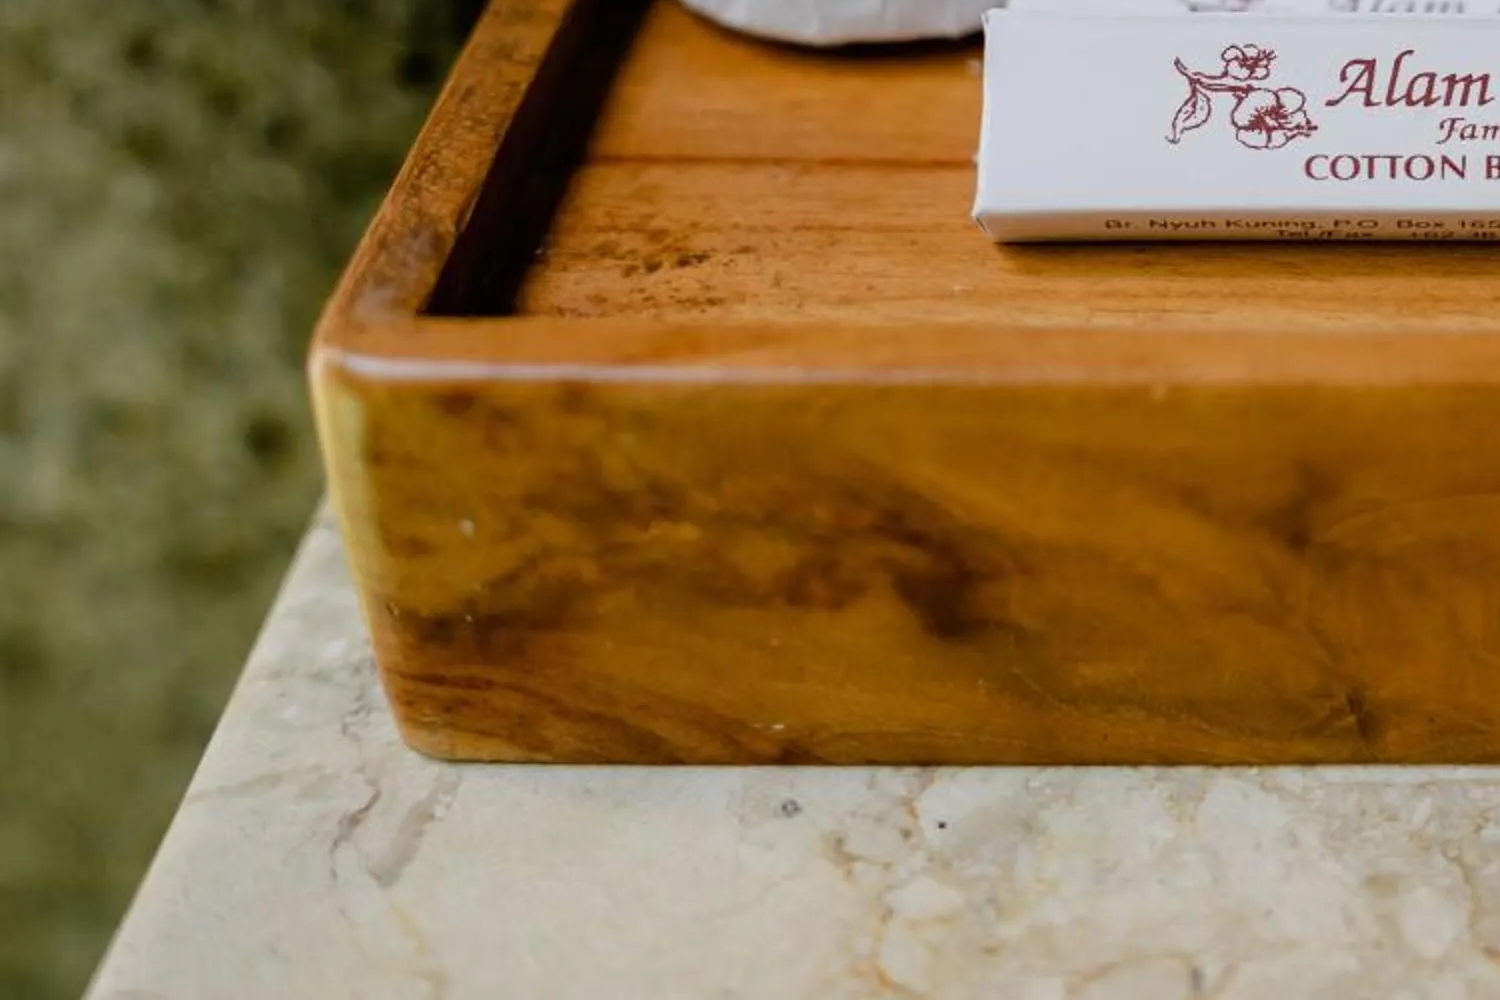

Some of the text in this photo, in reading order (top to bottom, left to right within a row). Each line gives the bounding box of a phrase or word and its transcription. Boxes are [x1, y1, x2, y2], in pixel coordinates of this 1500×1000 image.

[1325, 49, 1496, 108] Alam
[1303, 154, 1468, 182] COTTON
[1148, 218, 1217, 231] Nyuh
[1396, 218, 1445, 230] Box
